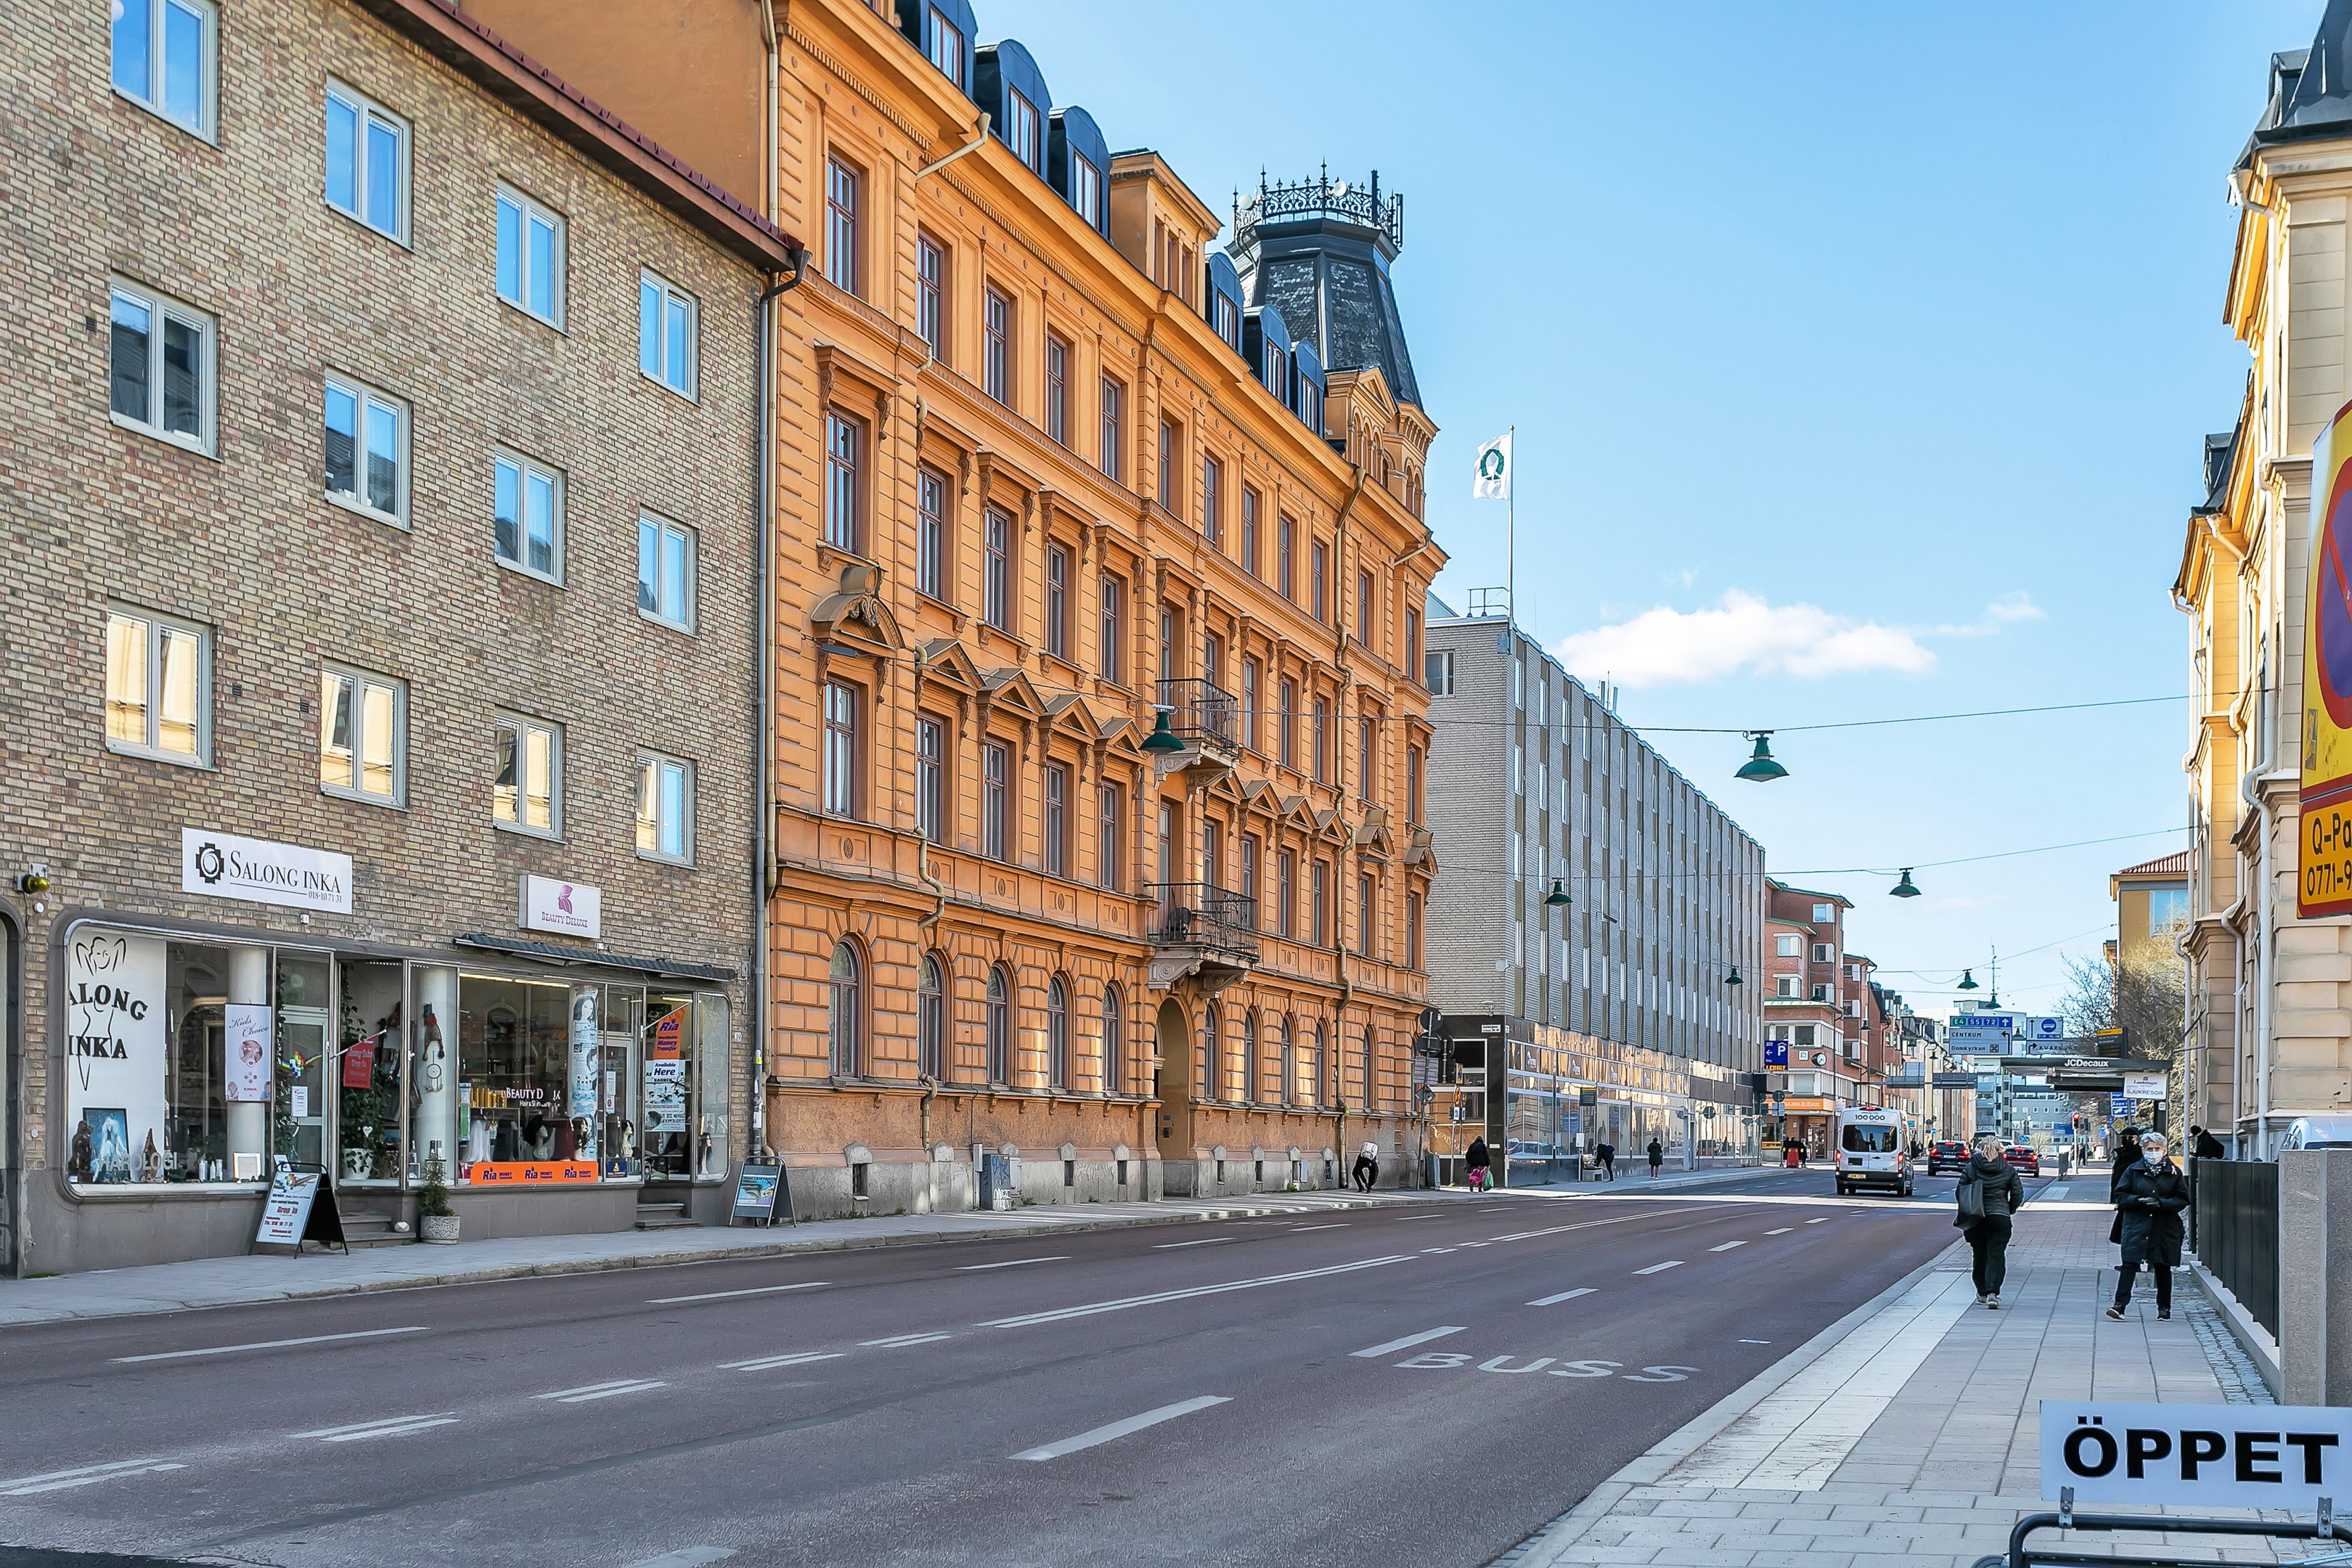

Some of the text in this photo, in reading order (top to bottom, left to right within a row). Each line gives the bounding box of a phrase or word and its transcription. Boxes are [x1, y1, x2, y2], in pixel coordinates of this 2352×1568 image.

[229, 850, 341, 893] SALONG INKA
[2307, 859, 2352, 897] 0771-9
[309, 891, 327, 901] 018-10
[328, 894, 335, 902] 71
[542, 911, 588, 928] BEAUTY DELUXE
[229, 1015, 252, 1029] Kids
[659, 1018, 679, 1032] Ria
[242, 1023, 269, 1037] Choice
[69, 1035, 128, 1059] INKA
[506, 1087, 536, 1099] BEAUTY
[483, 1167, 497, 1180] Ria
[525, 1166, 539, 1179] Ria
[564, 1165, 577, 1178] Ria
[1392, 1352, 1701, 1382] BUSS
[2063, 1415, 2340, 1485] ÖPPET
